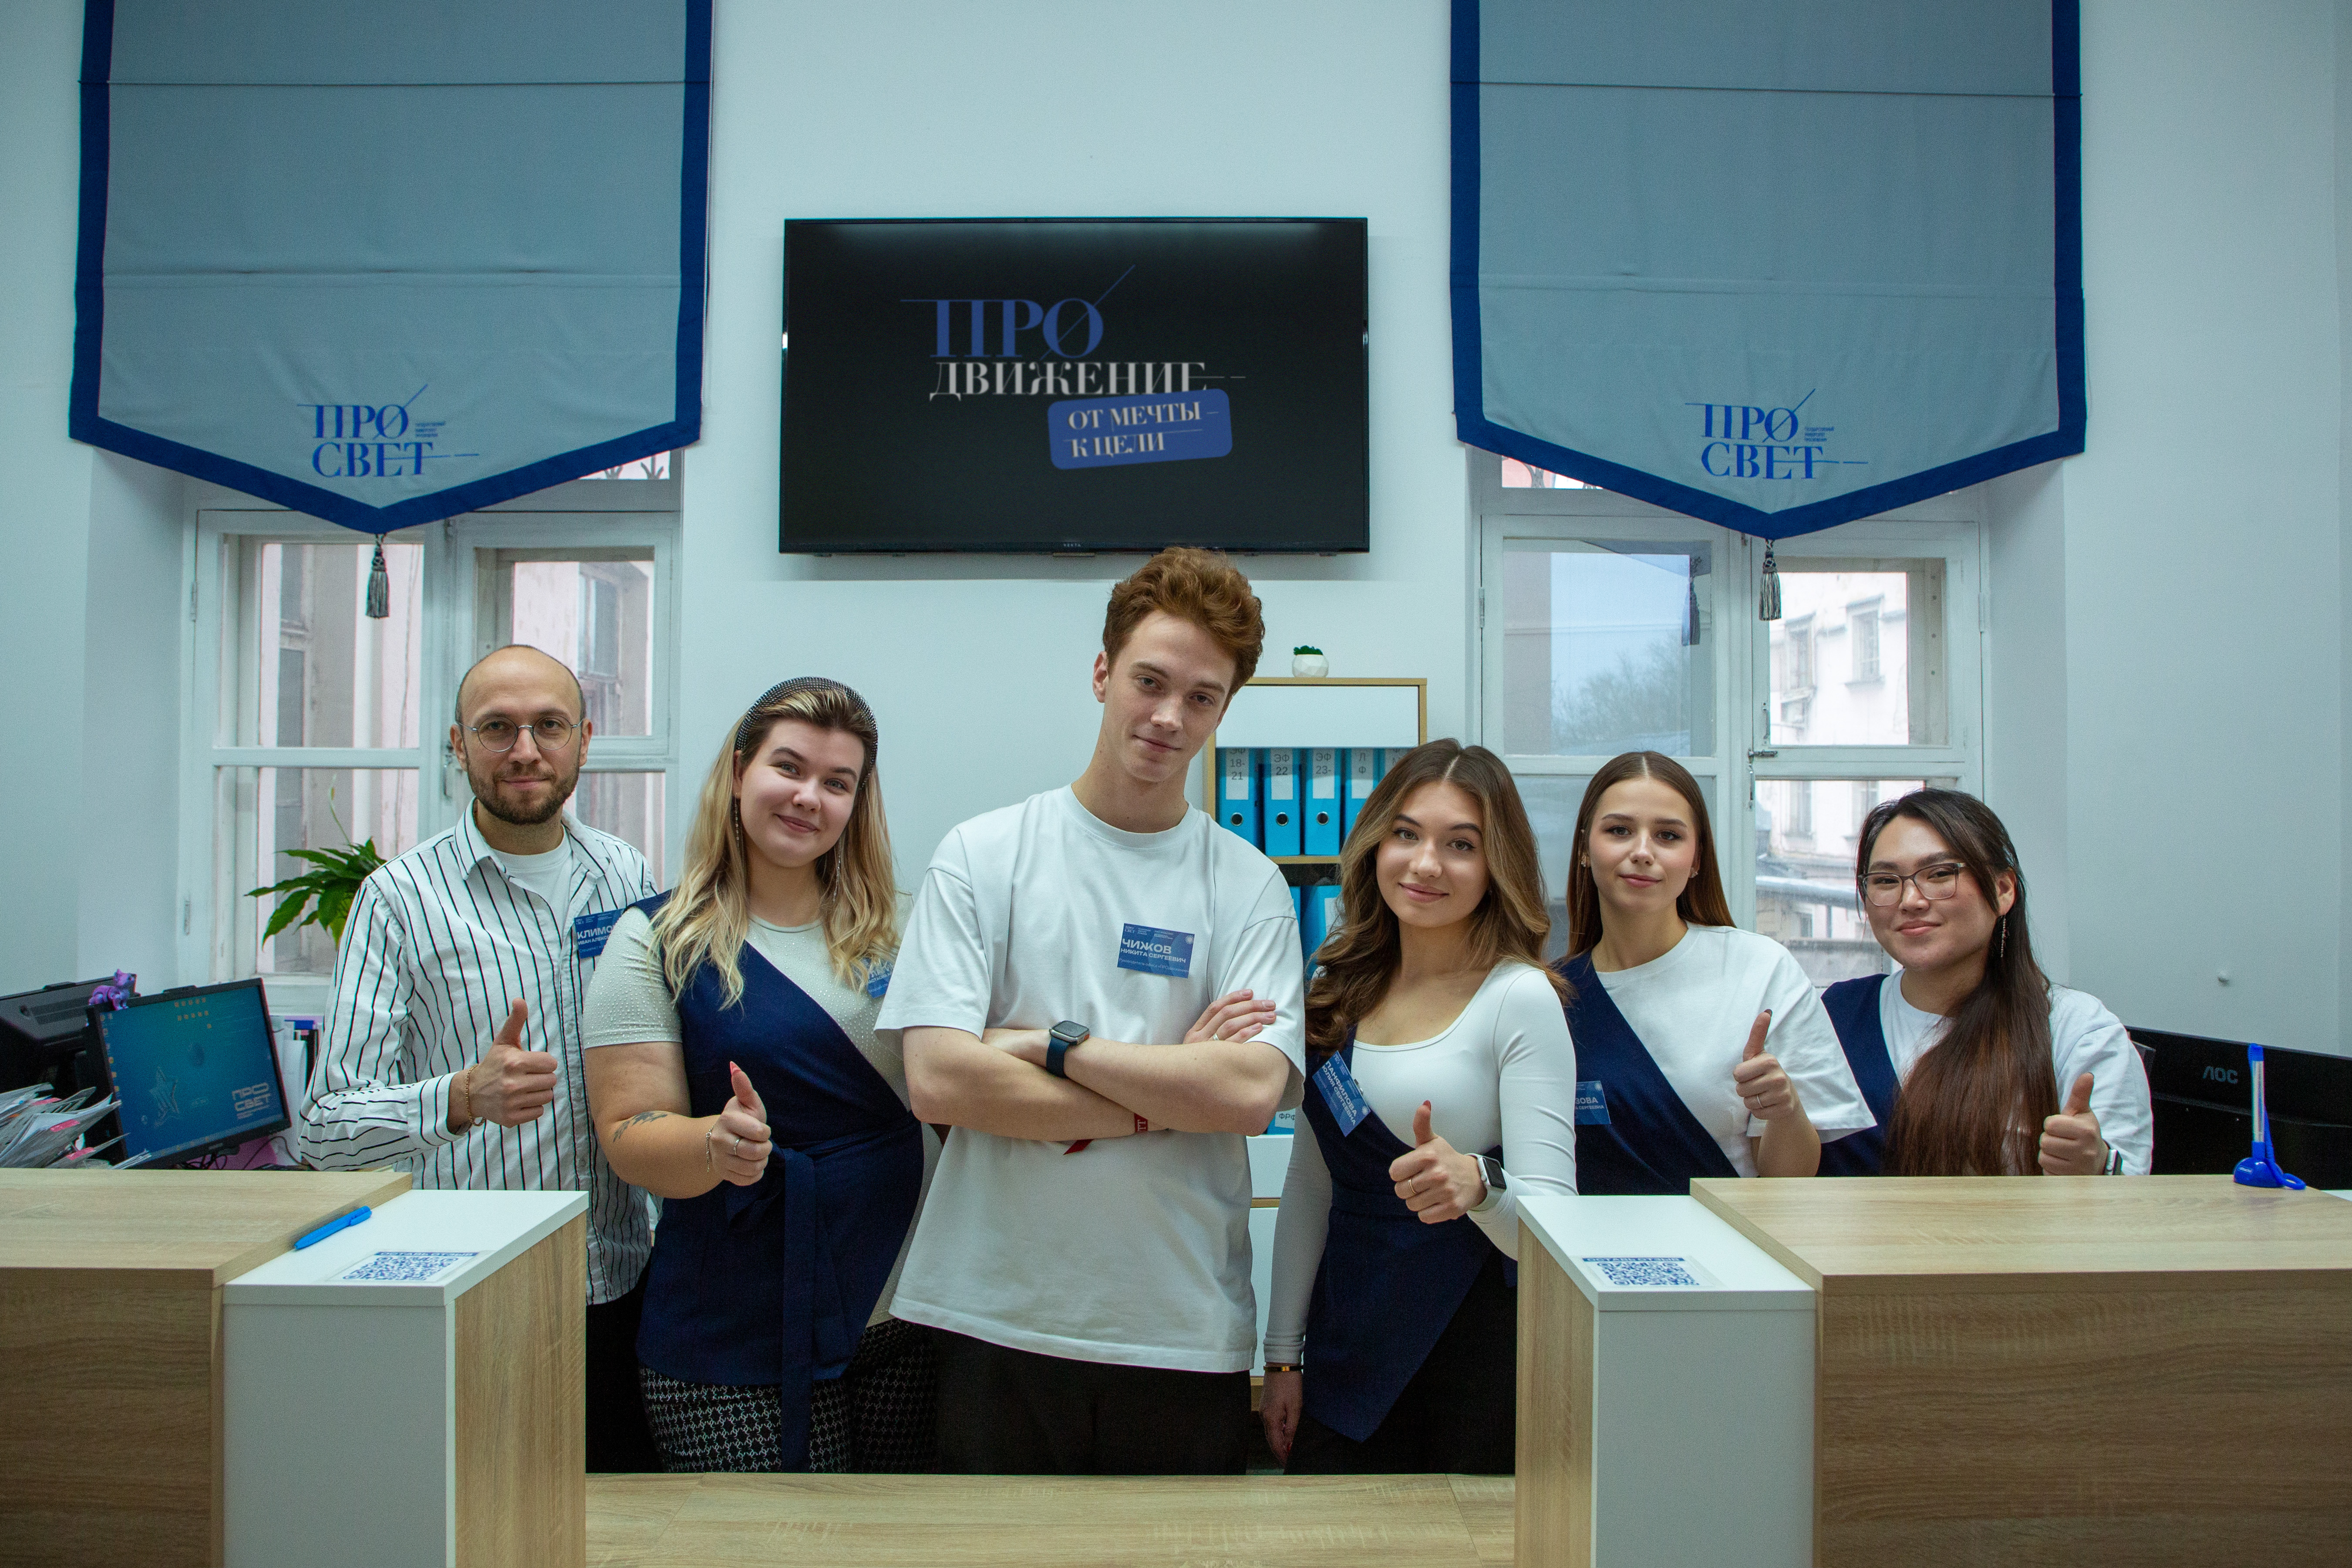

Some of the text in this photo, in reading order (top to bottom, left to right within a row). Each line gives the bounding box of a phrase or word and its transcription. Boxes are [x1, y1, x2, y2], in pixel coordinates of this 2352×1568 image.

[908, 297, 1104, 359] ПРО
[929, 361, 1206, 402] ДВИЖЕНИЕ
[300, 402, 410, 440] ПРО
[1067, 401, 1203, 432] ОТ МЕЧТЫ
[1690, 402, 1799, 442] ПРО
[1067, 432, 1166, 458] К ЦЕЛИ
[311, 441, 434, 478] СВЕТ
[1700, 441, 1823, 479] СВЕТ
[1274, 753, 1290, 763] ЭФ
[1276, 766, 1288, 776] 22
[1315, 752, 1331, 762] ЭФ
[1358, 765, 1367, 774] Ф
[1231, 771, 1243, 780] 21
[1120, 948, 1186, 963] НИКИТА СЕРГЕЕВИЧ
[1122, 938, 1172, 954] ЧИЖОВ
[1325, 1060, 1357, 1117] ПАНФИЛОВА
[2202, 1066, 2238, 1084] AOC
[1321, 1065, 1335, 1086] ЮЛИЯ
[1334, 1086, 1356, 1126] СЕРГЕЕВНА
